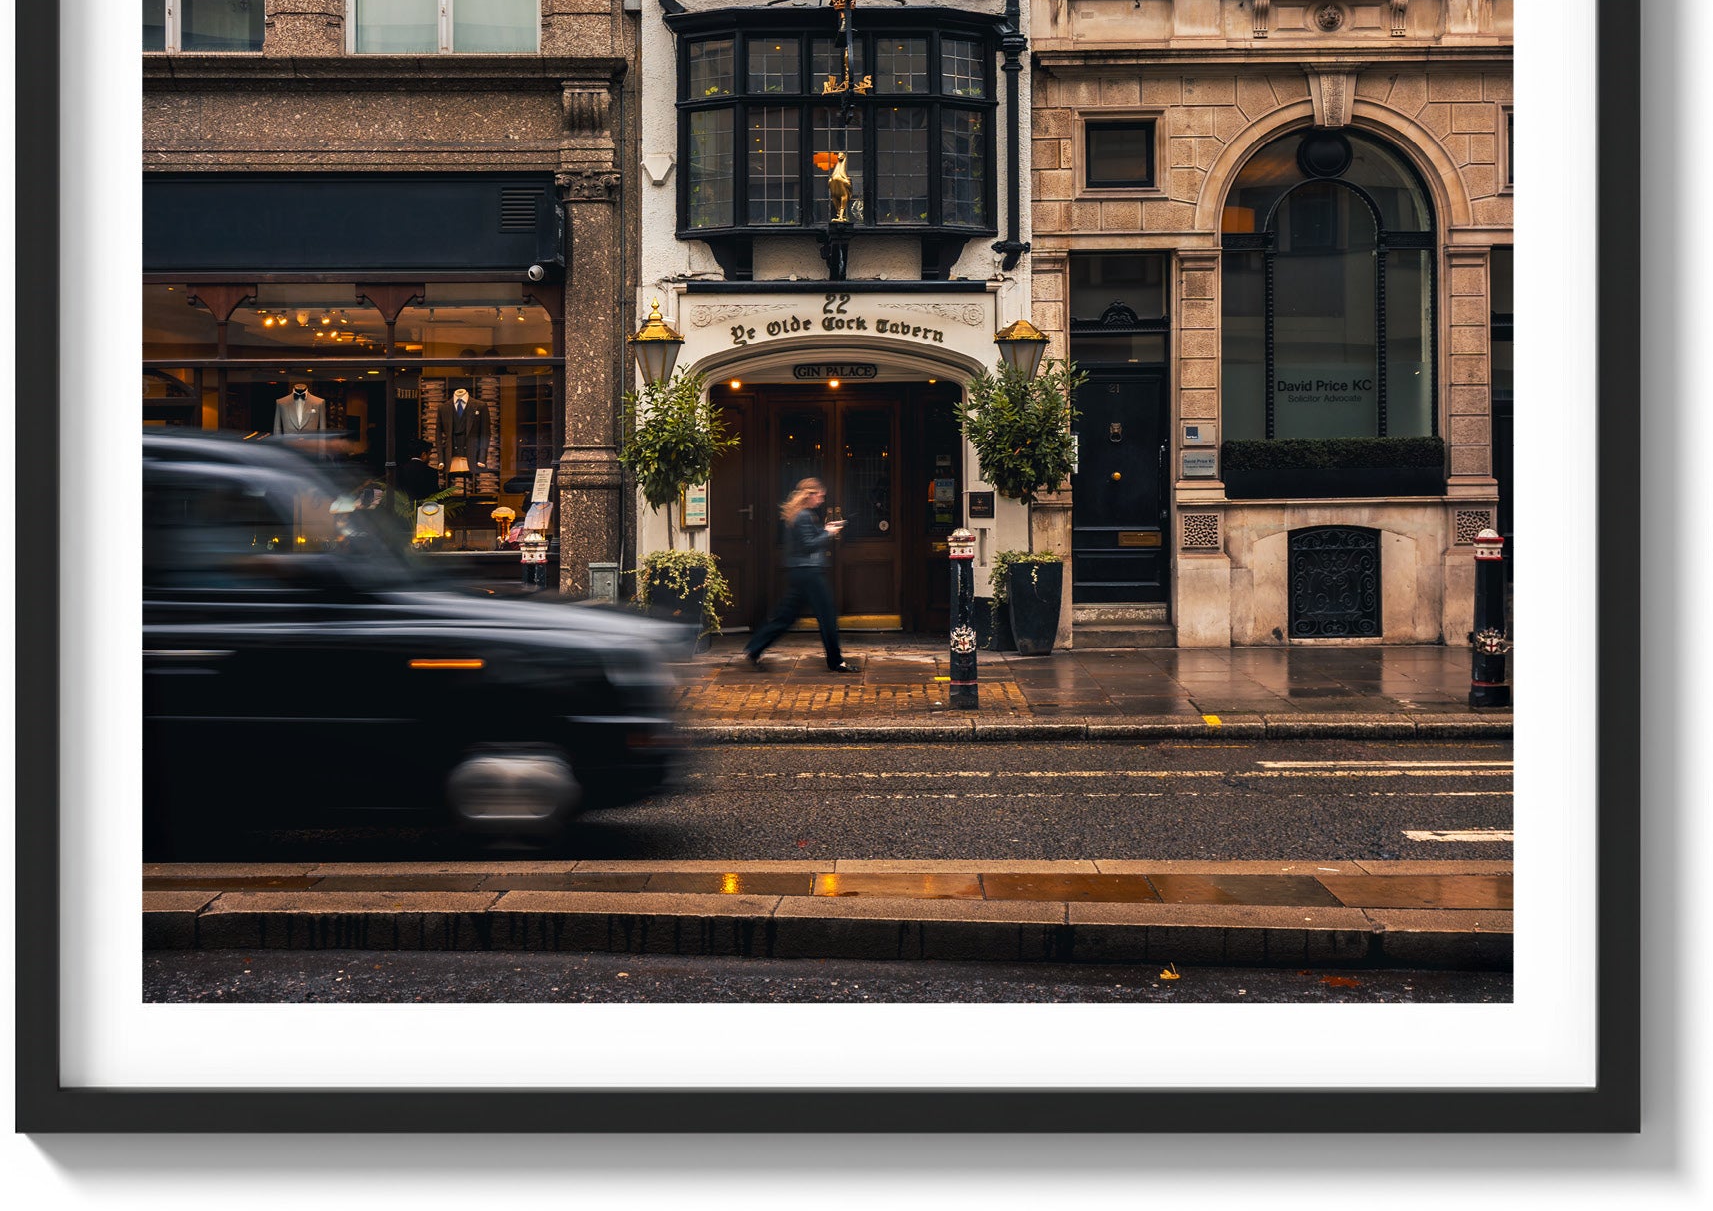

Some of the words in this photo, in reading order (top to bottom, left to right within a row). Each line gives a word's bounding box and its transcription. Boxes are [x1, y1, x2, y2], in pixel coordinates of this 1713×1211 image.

[822, 293, 851, 314] 22
[730, 324, 756, 347] Ye
[766, 315, 812, 336] Olde
[821, 315, 868, 331] Cock
[875, 318, 944, 343] Tavern
[796, 364, 820, 377] GIN
[825, 364, 872, 377] PALACE
[1109, 383, 1120, 393] 21
[1277, 380, 1312, 391] David
[1316, 380, 1348, 391] Price
[1352, 379, 1372, 390] KC
[1288, 394, 1320, 402] Solicitor
[1323, 394, 1362, 402] Advocate
